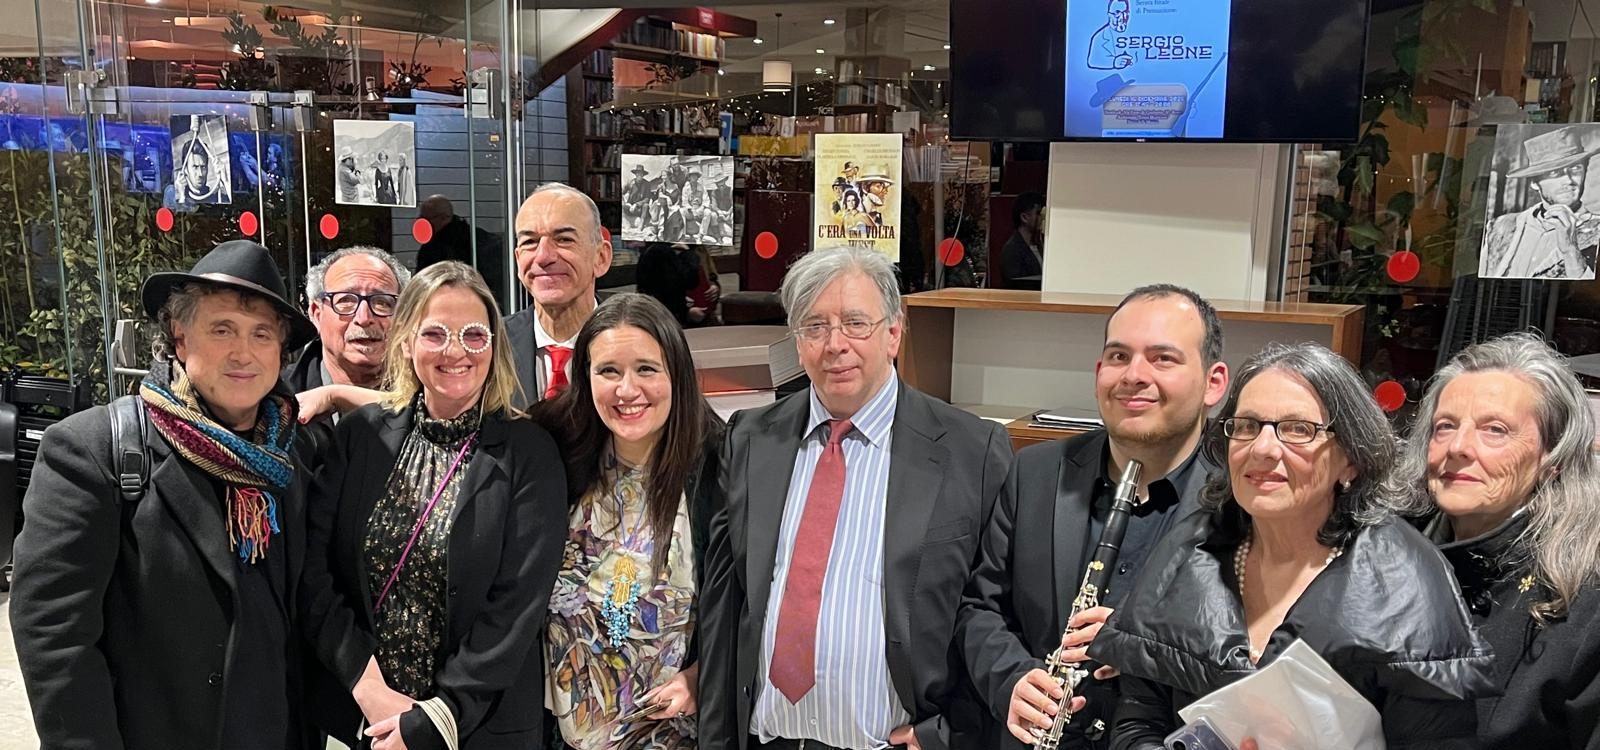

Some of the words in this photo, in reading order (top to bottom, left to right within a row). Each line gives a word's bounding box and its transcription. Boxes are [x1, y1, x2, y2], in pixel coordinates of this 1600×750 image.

[1115, 35, 1184, 49] SERGIO
[1145, 46, 1213, 60] LEONE
[818, 224, 846, 239] C'ERA
[849, 229, 862, 239] UNA
[865, 225, 896, 239] VOLTA
